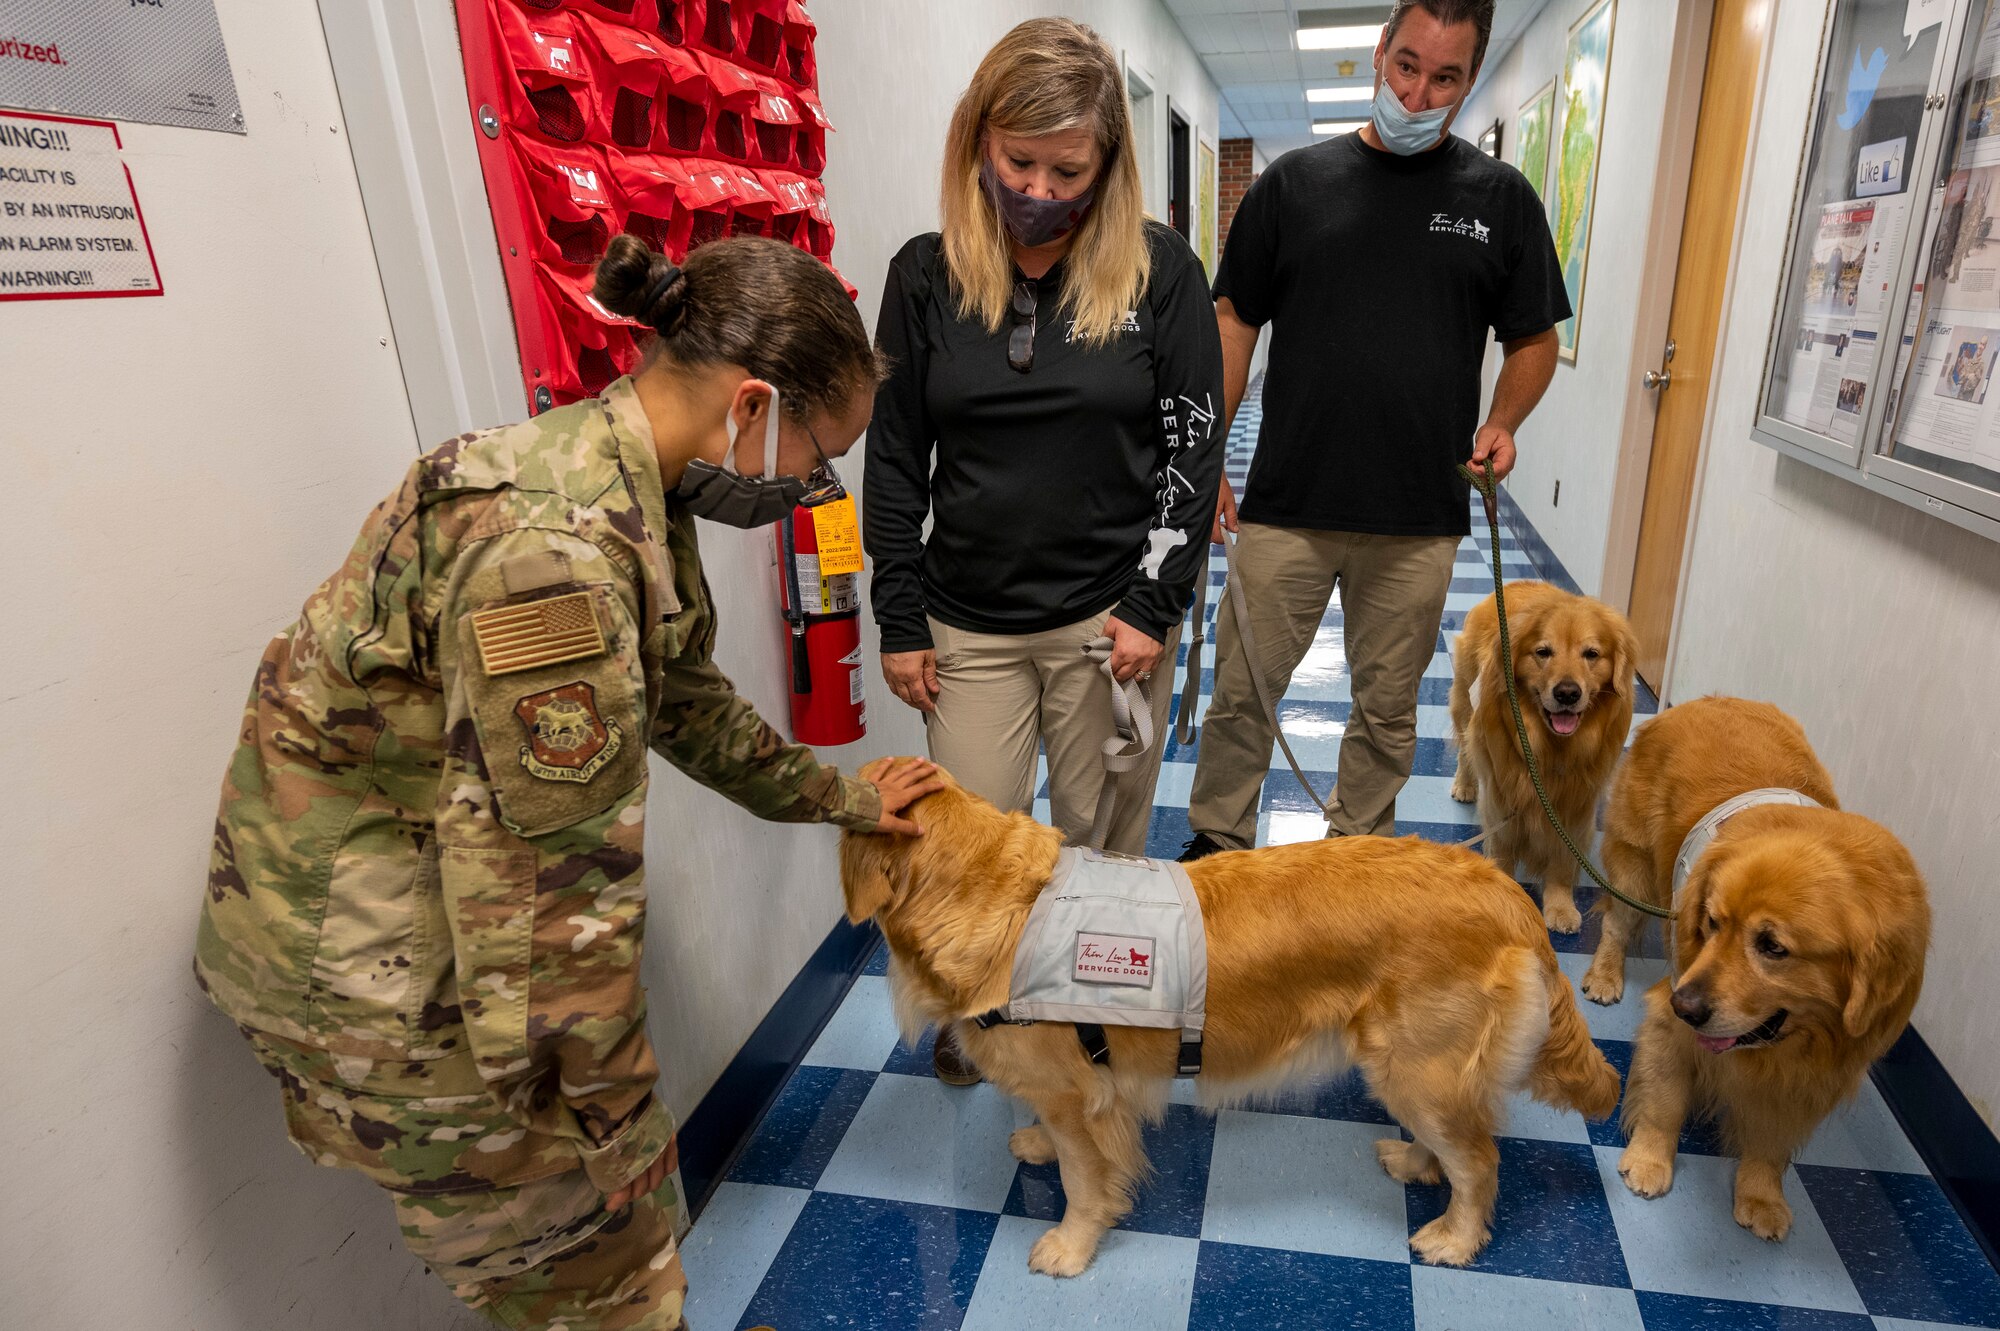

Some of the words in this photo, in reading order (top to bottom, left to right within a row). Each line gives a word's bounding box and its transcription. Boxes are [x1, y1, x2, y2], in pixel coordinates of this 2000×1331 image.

[60, 171, 76, 186] IS
[1860, 160, 1880, 184] Like
[4, 202, 25, 216] BY
[32, 203, 53, 218] AN
[55, 204, 135, 220] INTRUSION
[1430, 213, 1452, 226] Thin
[1454, 217, 1474, 230] Line
[1429, 226, 1466, 235] SERVICE
[1469, 232, 1488, 243] DOGS
[19, 236, 73, 251] ALARM
[75, 237, 138, 252] SYSTEM.
[1113, 324, 1141, 332] DOGS
[822, 579, 828, 588] B
[823, 598, 829, 607] C
[1080, 943, 1103, 960] Thin
[1106, 947, 1129, 964] Line
[1078, 965, 1119, 973] SERVICE
